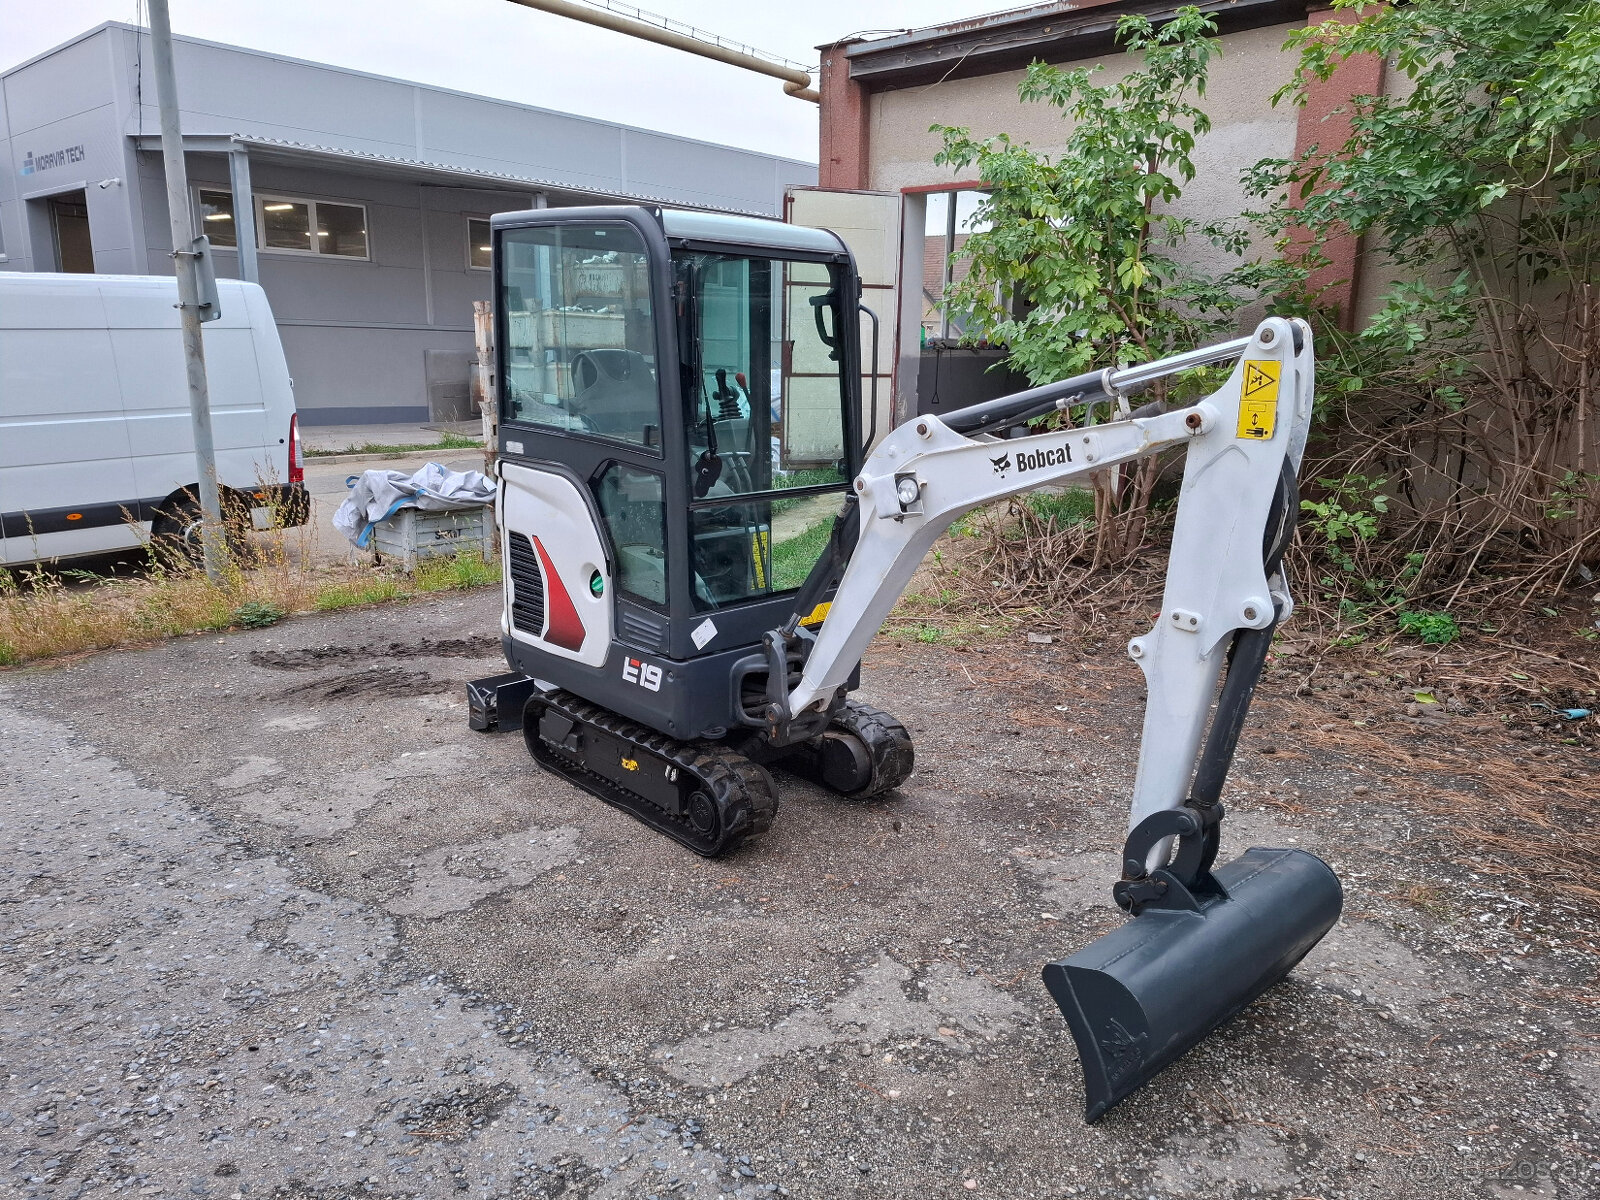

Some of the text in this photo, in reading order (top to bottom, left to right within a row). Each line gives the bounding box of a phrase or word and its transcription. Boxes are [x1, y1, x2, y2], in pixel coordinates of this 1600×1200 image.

[35, 144, 84, 172] MORAVIA TECH
[1015, 443, 1072, 472] Bobcat
[622, 656, 662, 692] E19
